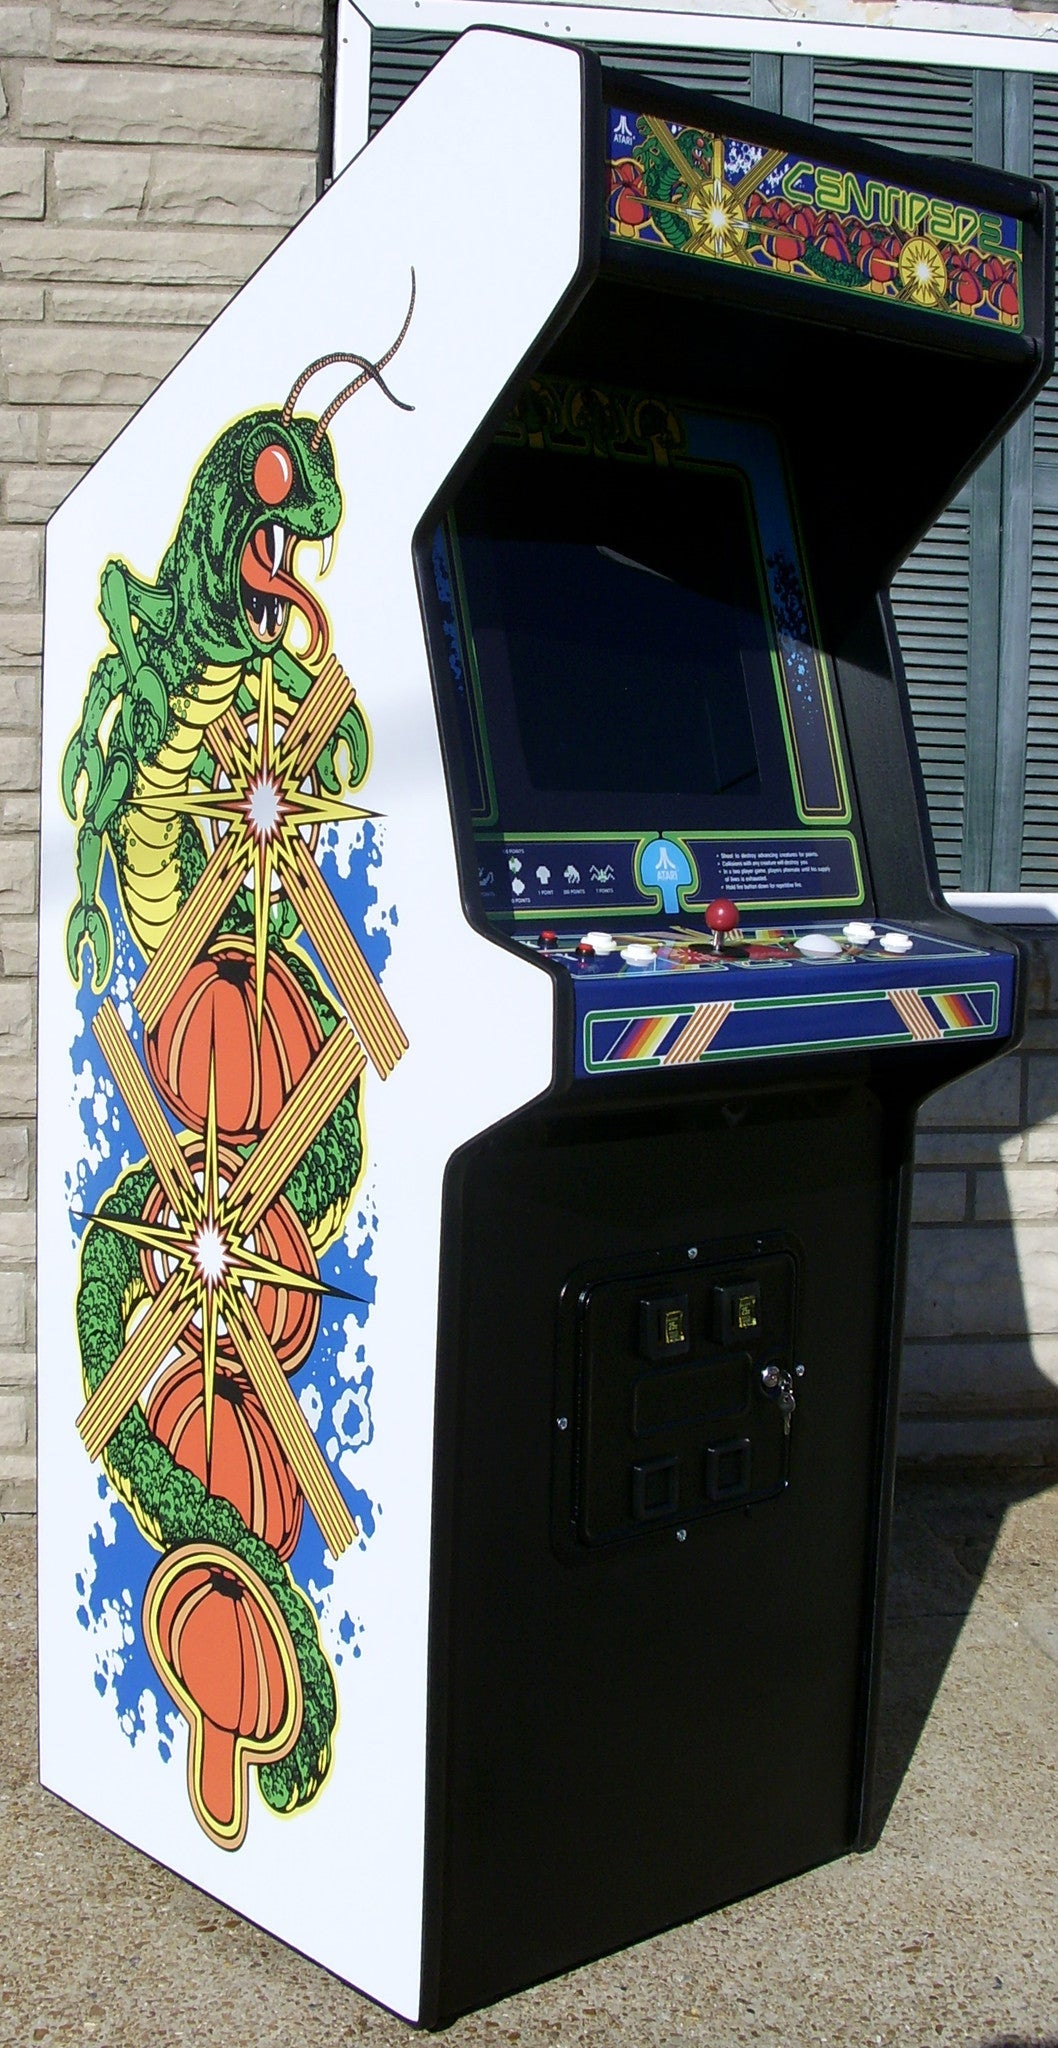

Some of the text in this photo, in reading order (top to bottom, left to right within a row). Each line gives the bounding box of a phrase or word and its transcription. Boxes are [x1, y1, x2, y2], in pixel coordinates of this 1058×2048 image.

[613, 133, 633, 146] ATARI
[781, 161, 1004, 253] CENTIPEDE
[657, 870, 678, 881] ATARI
